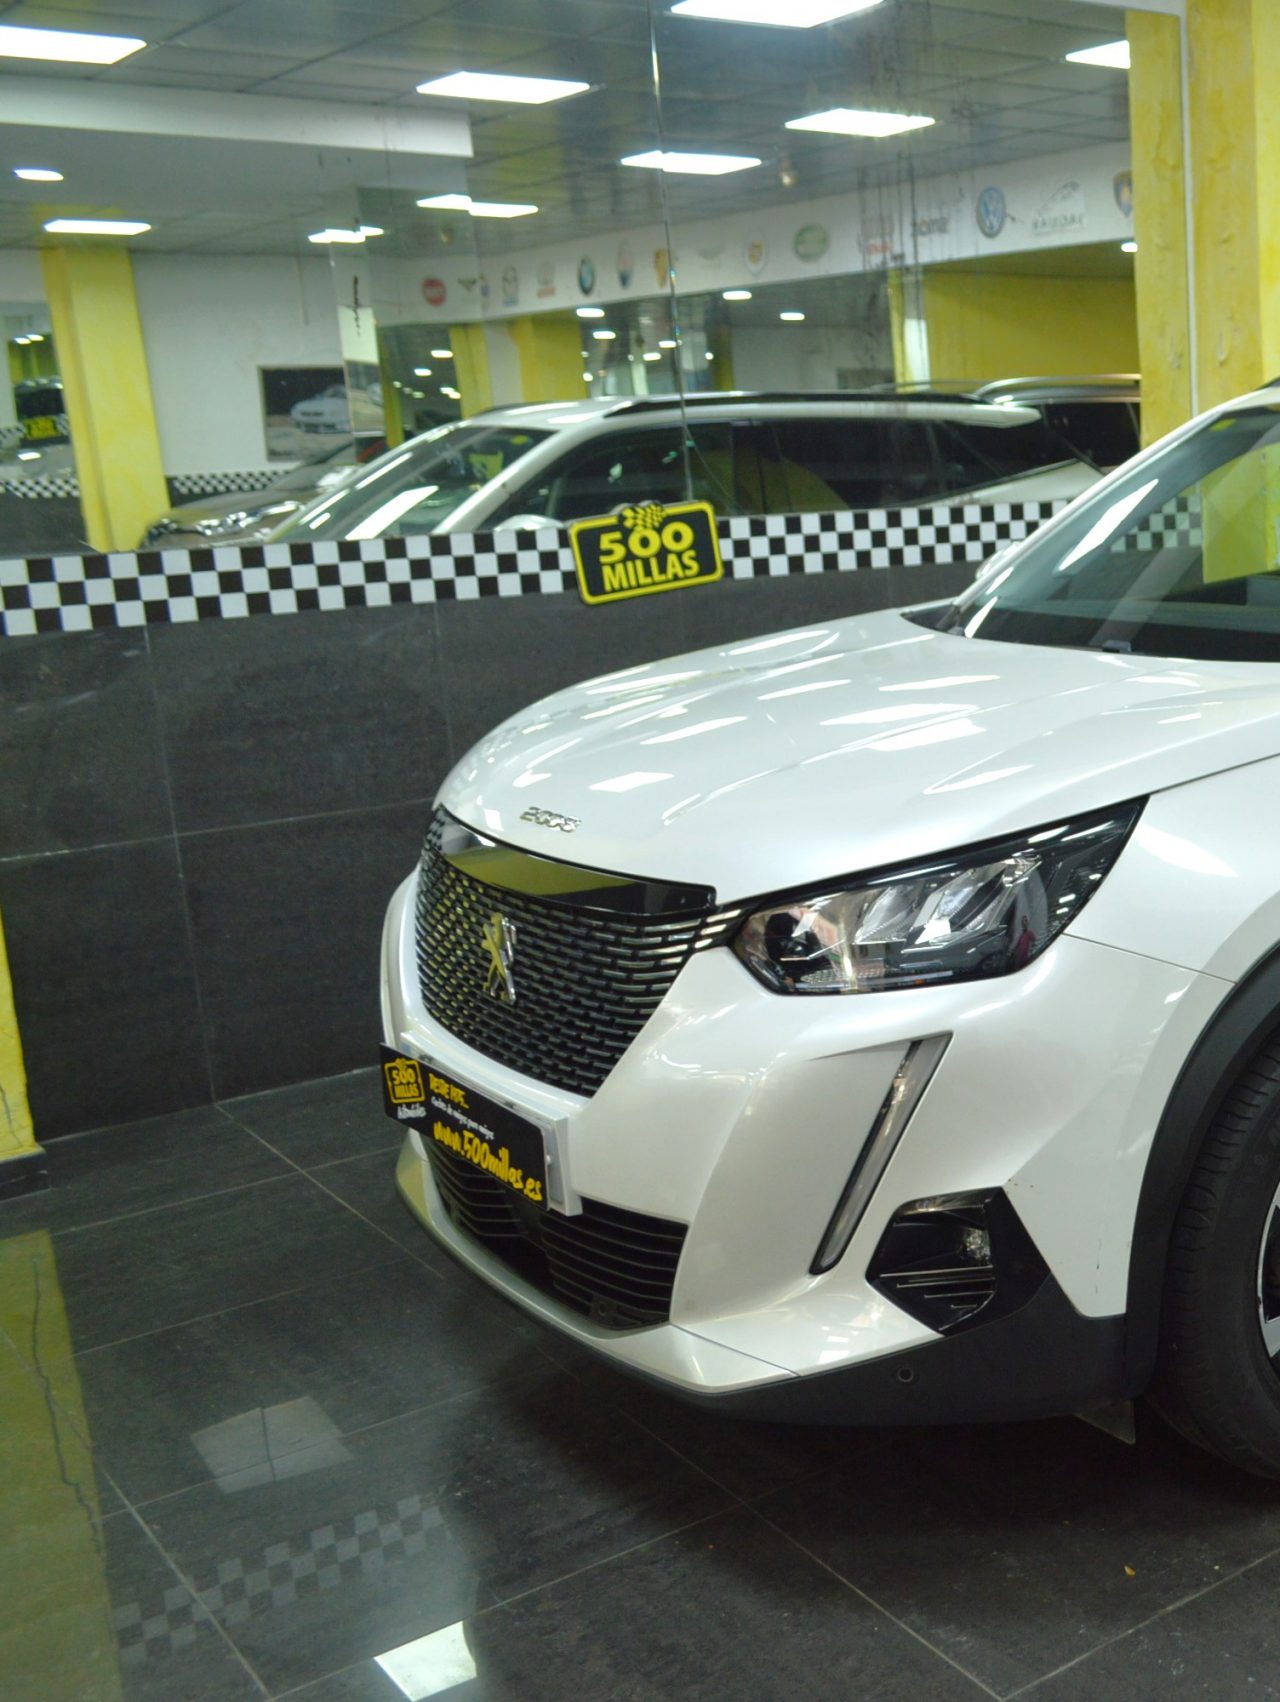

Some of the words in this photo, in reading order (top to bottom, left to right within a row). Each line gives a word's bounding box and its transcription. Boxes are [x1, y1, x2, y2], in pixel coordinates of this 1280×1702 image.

[599, 521, 694, 564] 500
[602, 549, 700, 592] MILLAS
[392, 1068, 416, 1084] 500
[434, 1120, 542, 1201] www.500millas.es
